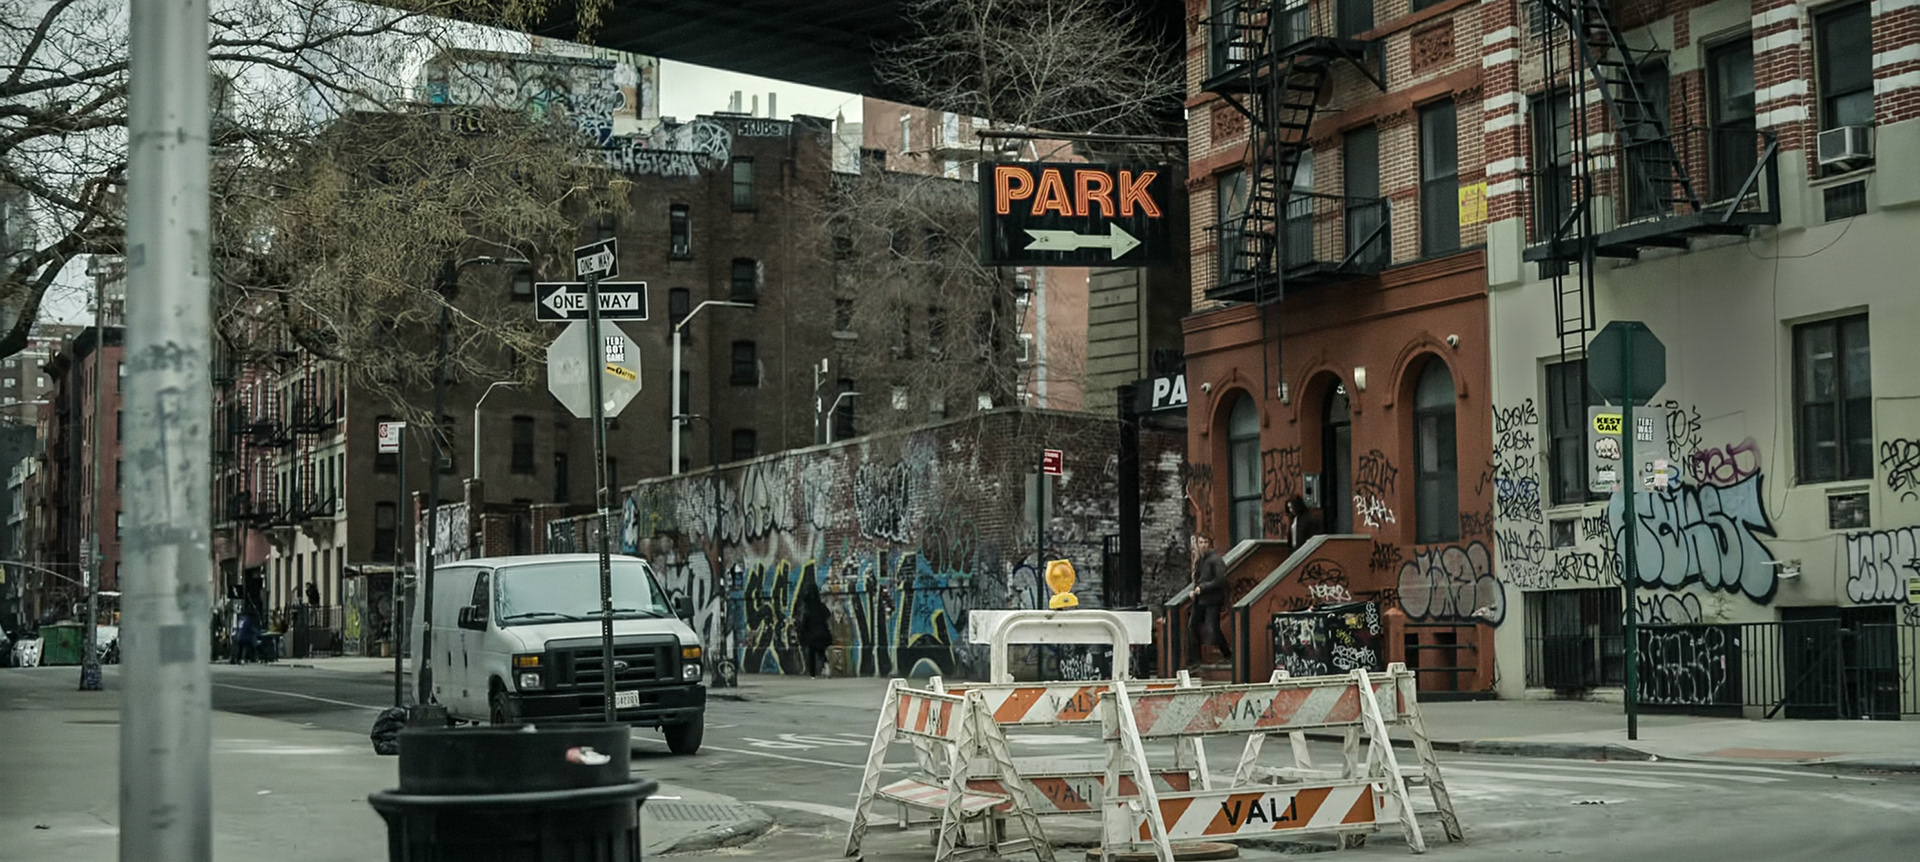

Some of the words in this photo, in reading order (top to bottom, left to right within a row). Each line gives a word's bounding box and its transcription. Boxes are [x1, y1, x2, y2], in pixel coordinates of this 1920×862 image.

[995, 166, 1162, 218] PARK
[581, 257, 593, 274] ONE
[598, 253, 612, 270] WAY
[553, 294, 584, 309] ONE
[598, 294, 632, 309] WAY
[605, 336, 625, 345] TEDZ
[605, 345, 625, 354] GOT
[606, 353, 625, 362] GAME
[1152, 374, 1188, 408] PA
[1050, 693, 1096, 714] VALI
[1229, 698, 1275, 720] VALI
[1048, 783, 1092, 803] VALI
[1220, 796, 1298, 826] VALI
